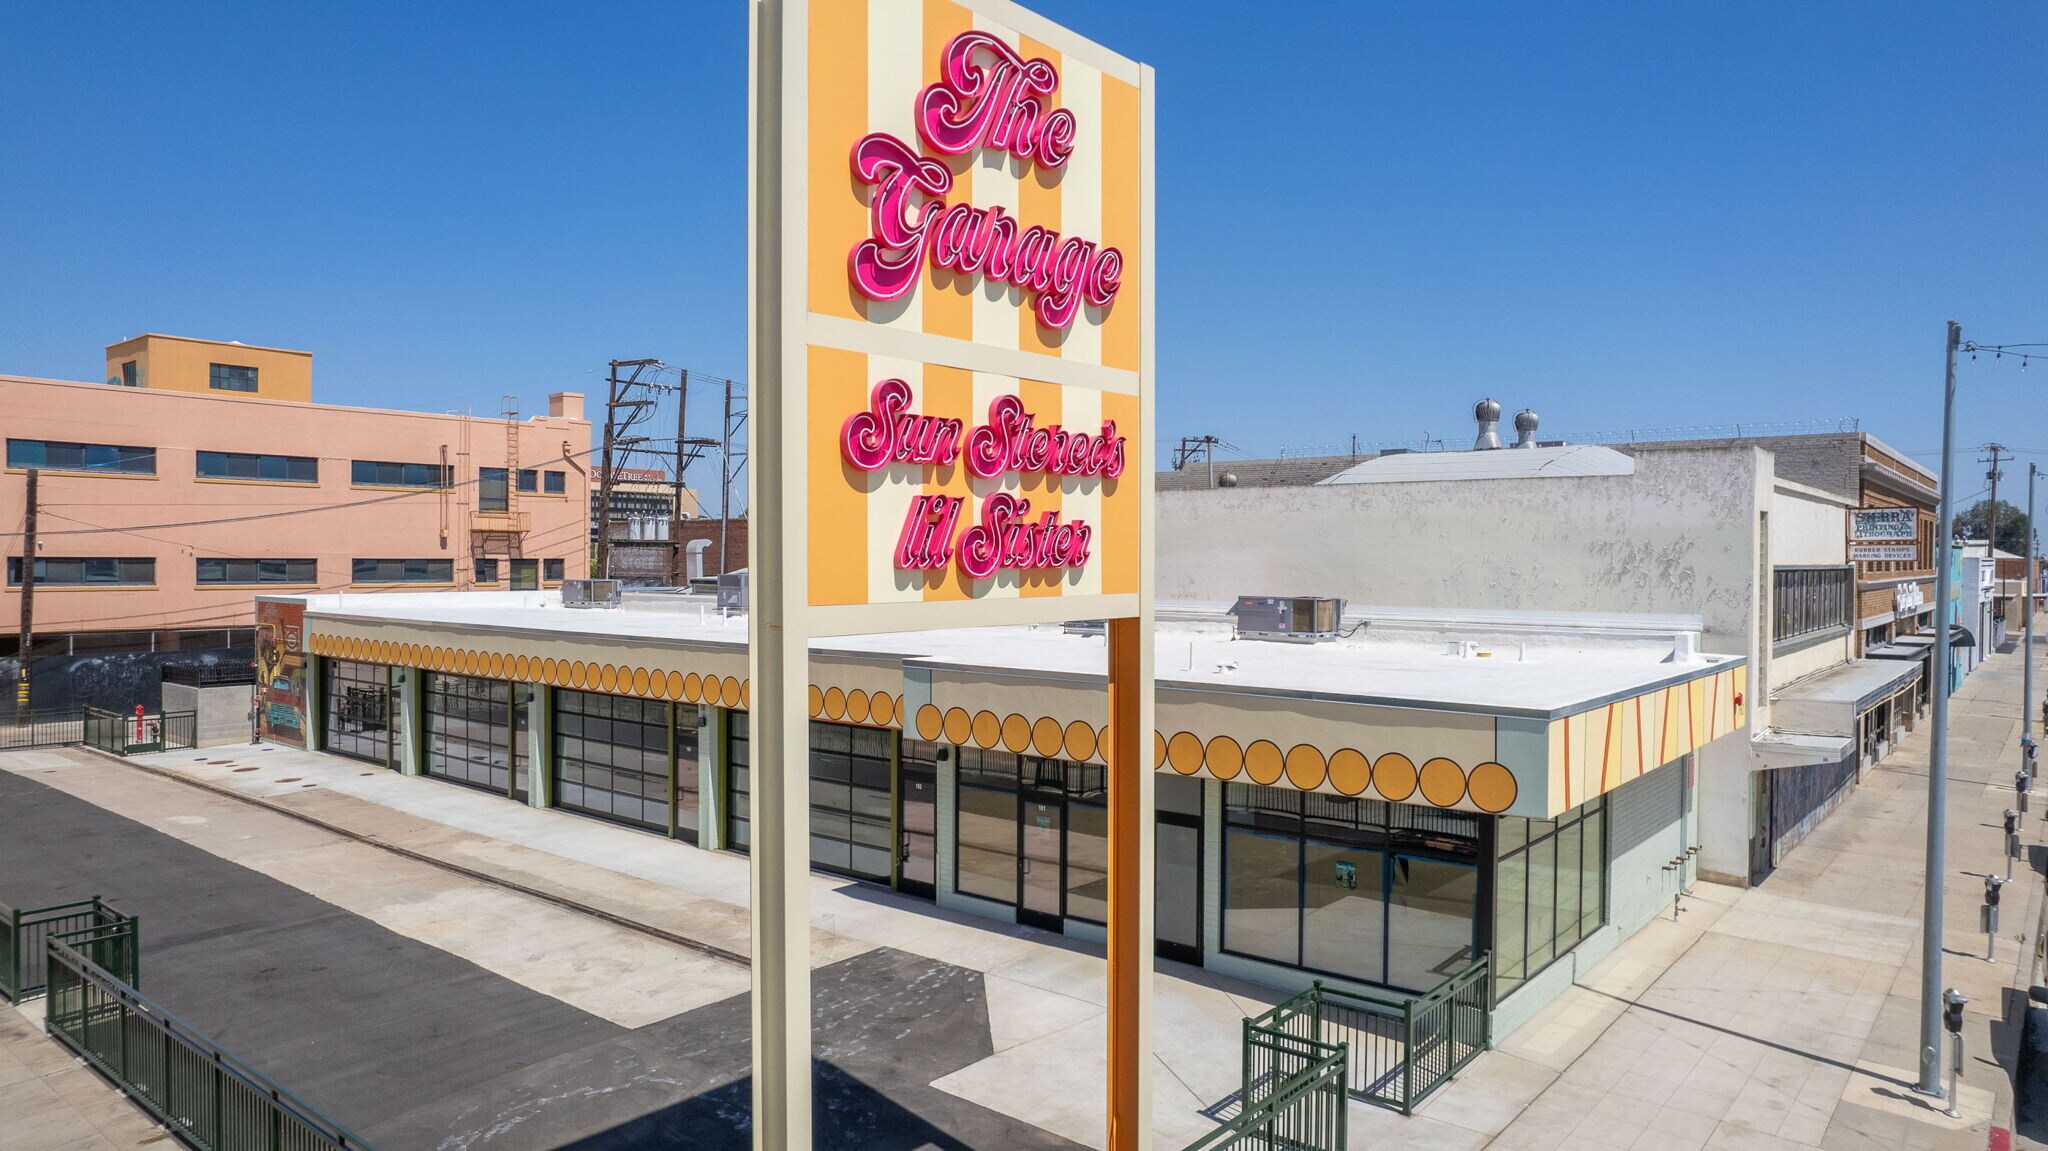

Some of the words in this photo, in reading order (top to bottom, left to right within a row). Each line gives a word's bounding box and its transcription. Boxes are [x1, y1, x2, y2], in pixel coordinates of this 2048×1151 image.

[915, 30, 1077, 171] The
[848, 133, 1123, 329] Garage
[840, 378, 963, 472] Sun
[956, 492, 1092, 579] Sister
[1855, 510, 1914, 524] SIERRA
